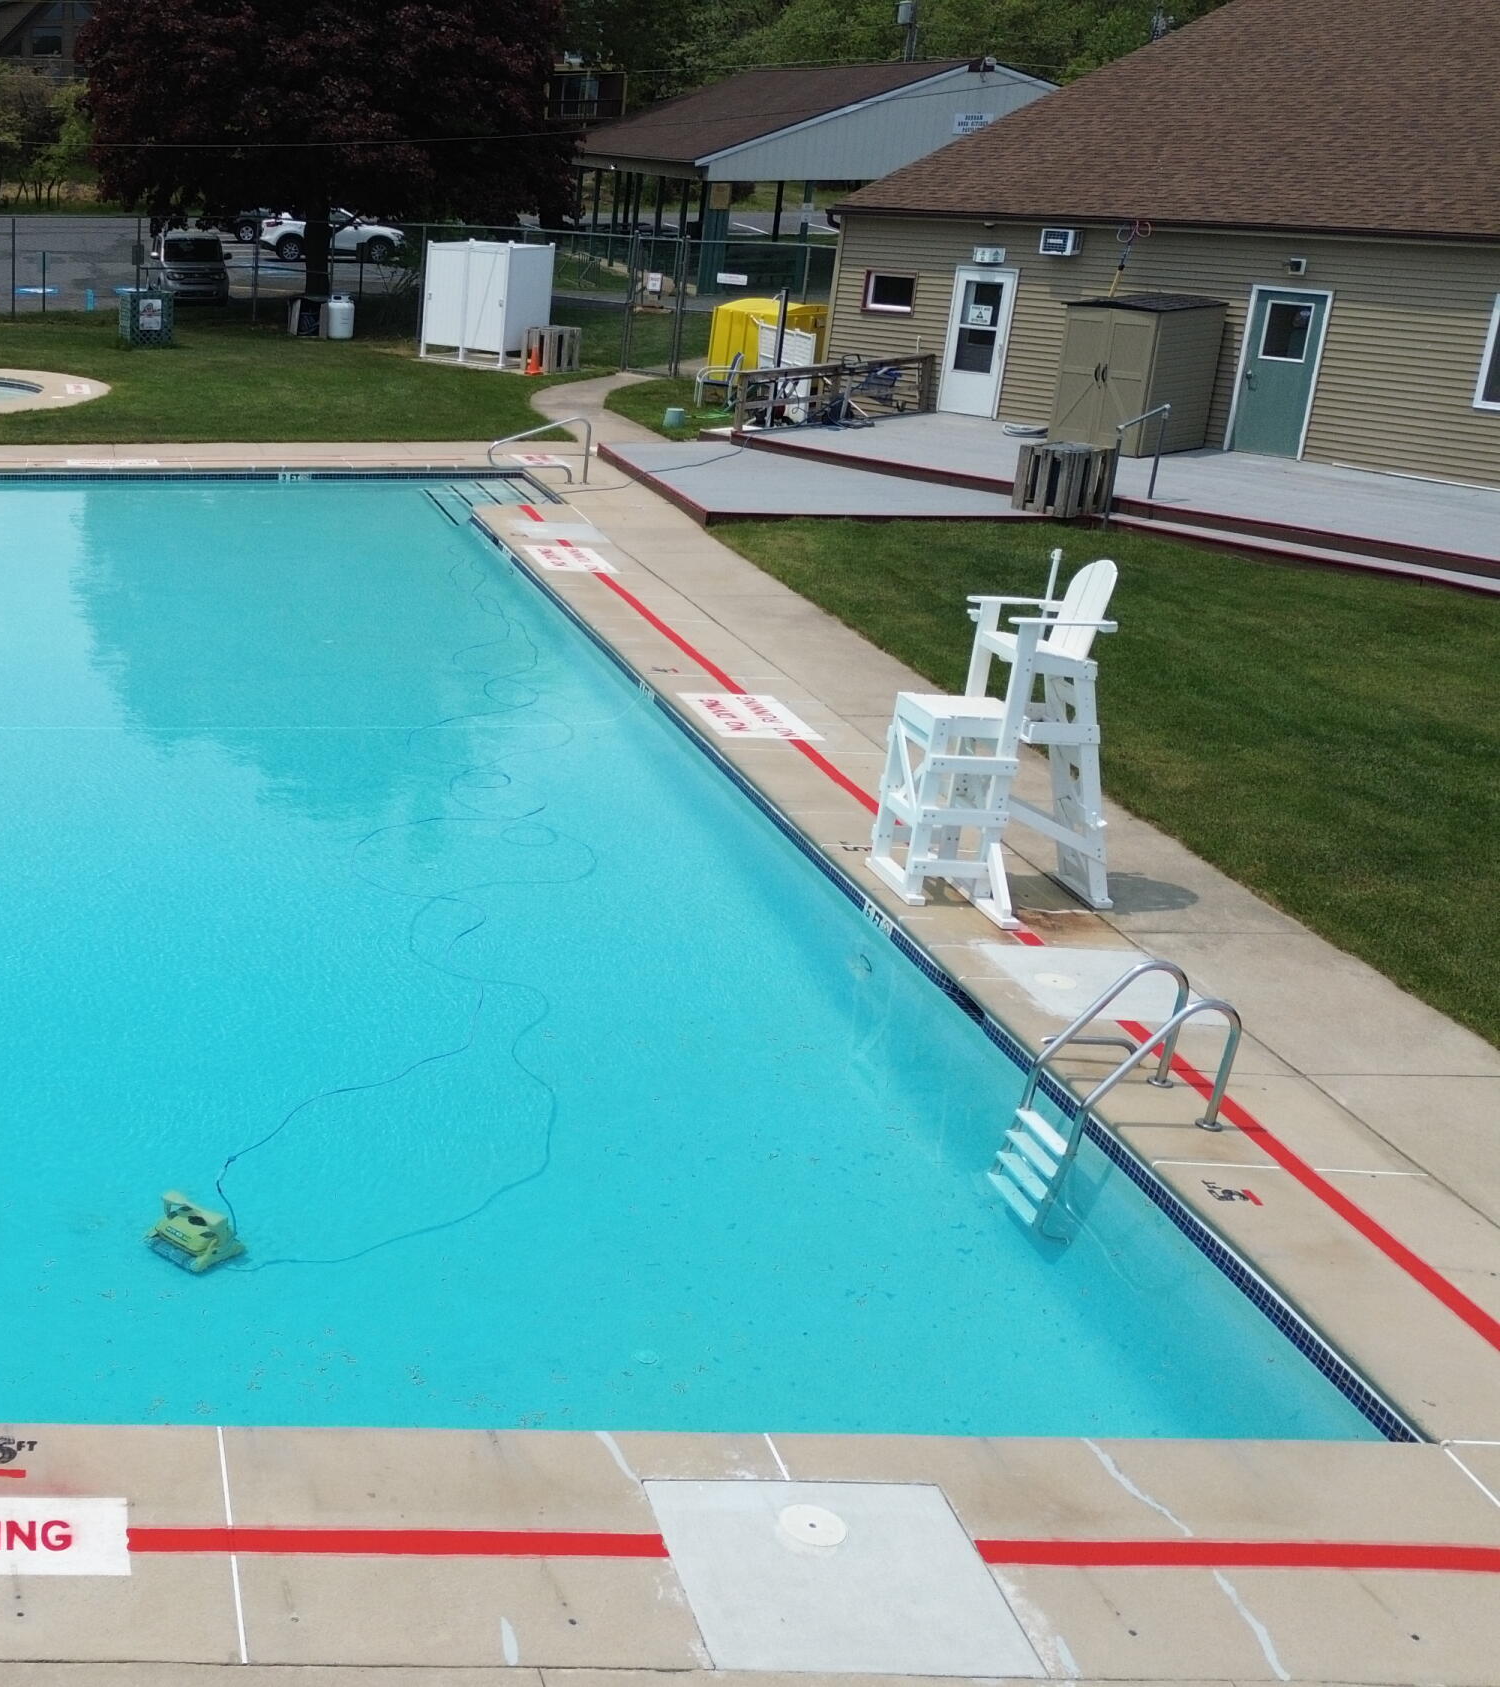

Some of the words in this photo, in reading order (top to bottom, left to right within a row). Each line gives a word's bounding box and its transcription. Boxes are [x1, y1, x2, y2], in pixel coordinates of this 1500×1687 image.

[699, 699, 738, 719] DIVING
[736, 696, 783, 724] RUNNING
[725, 721, 751, 732] NO
[773, 727, 801, 738] NO
[872, 910, 884, 928] FT
